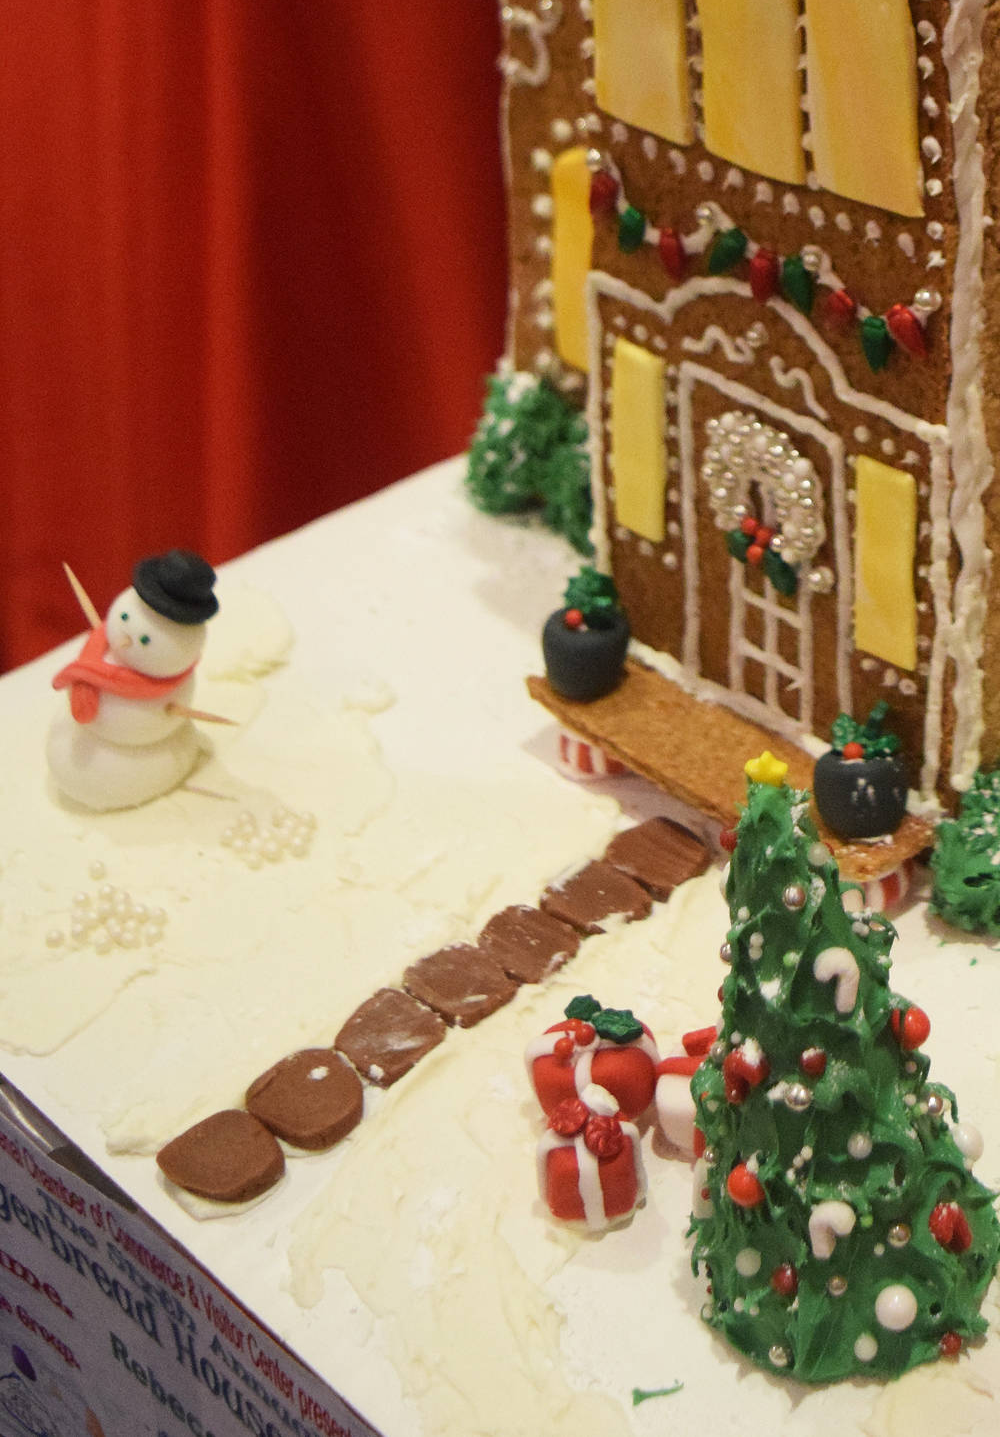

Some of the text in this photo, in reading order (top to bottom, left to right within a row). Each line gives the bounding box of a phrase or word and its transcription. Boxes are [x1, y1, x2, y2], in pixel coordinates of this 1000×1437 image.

[36, 1187, 98, 1248] The
[209, 1334, 320, 1437] Annua
[90, 1203, 107, 1231] of
[105, 1211, 186, 1298] Commerce
[187, 1274, 200, 1311] &
[200, 1283, 245, 1353] Visitor
[247, 1332, 295, 1404] Center
[109, 1331, 216, 1437] Rebec
